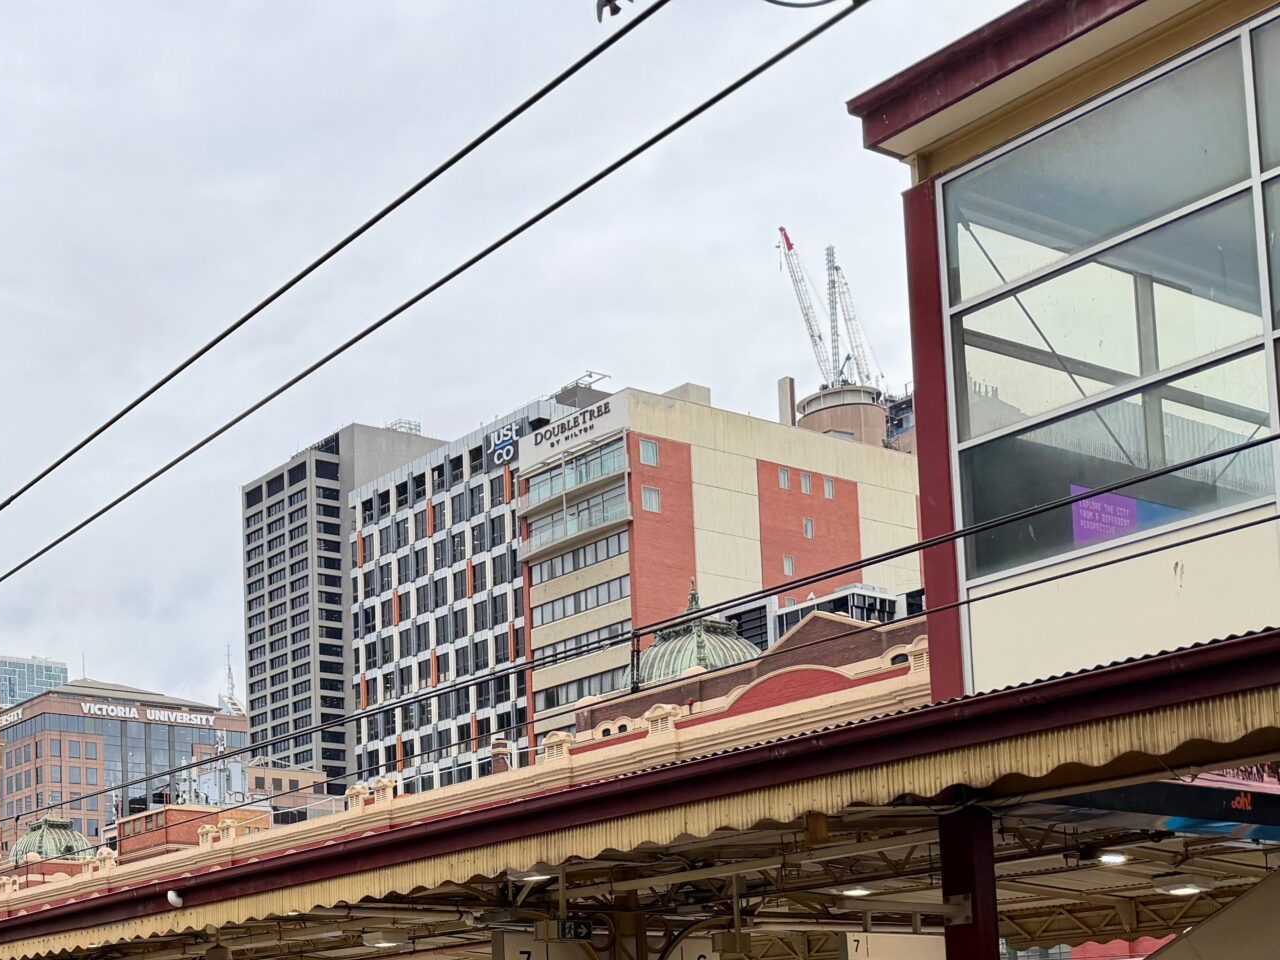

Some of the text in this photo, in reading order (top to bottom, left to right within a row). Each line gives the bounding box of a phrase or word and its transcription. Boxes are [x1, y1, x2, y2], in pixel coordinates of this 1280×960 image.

[550, 424, 594, 448] BY HILTON
[1080, 510, 1093, 520] FROM
[1101, 514, 1130, 528] DIFFERENT
[1104, 504, 1114, 514] THE
[1117, 507, 1130, 516] CITY
[80, 702, 216, 727] VICTORIA UNIVERSITY
[853, 939, 860, 953] 7
